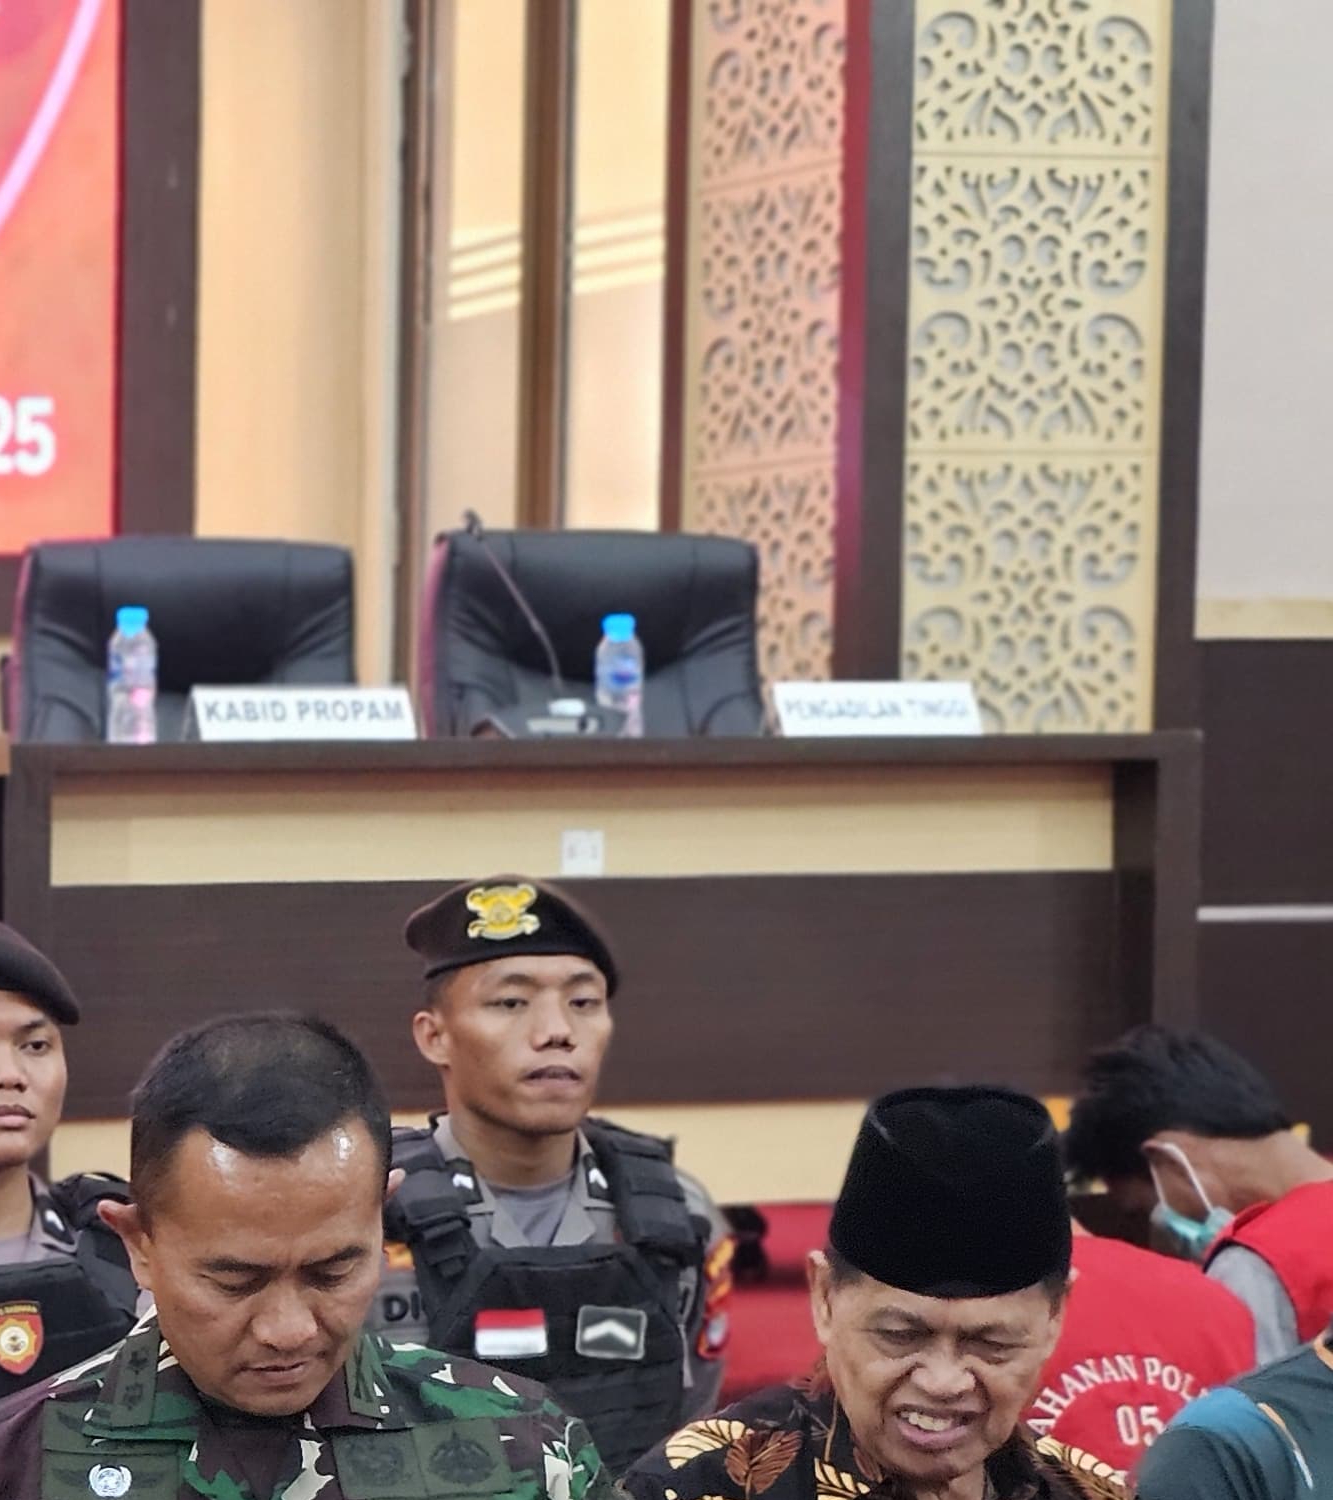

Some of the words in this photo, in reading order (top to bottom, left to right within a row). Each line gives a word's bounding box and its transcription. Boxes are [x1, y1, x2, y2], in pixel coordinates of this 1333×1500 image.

[204, 699, 287, 722] KABID
[295, 699, 405, 722] PROPAM
[1115, 1403, 1167, 1448] 05
